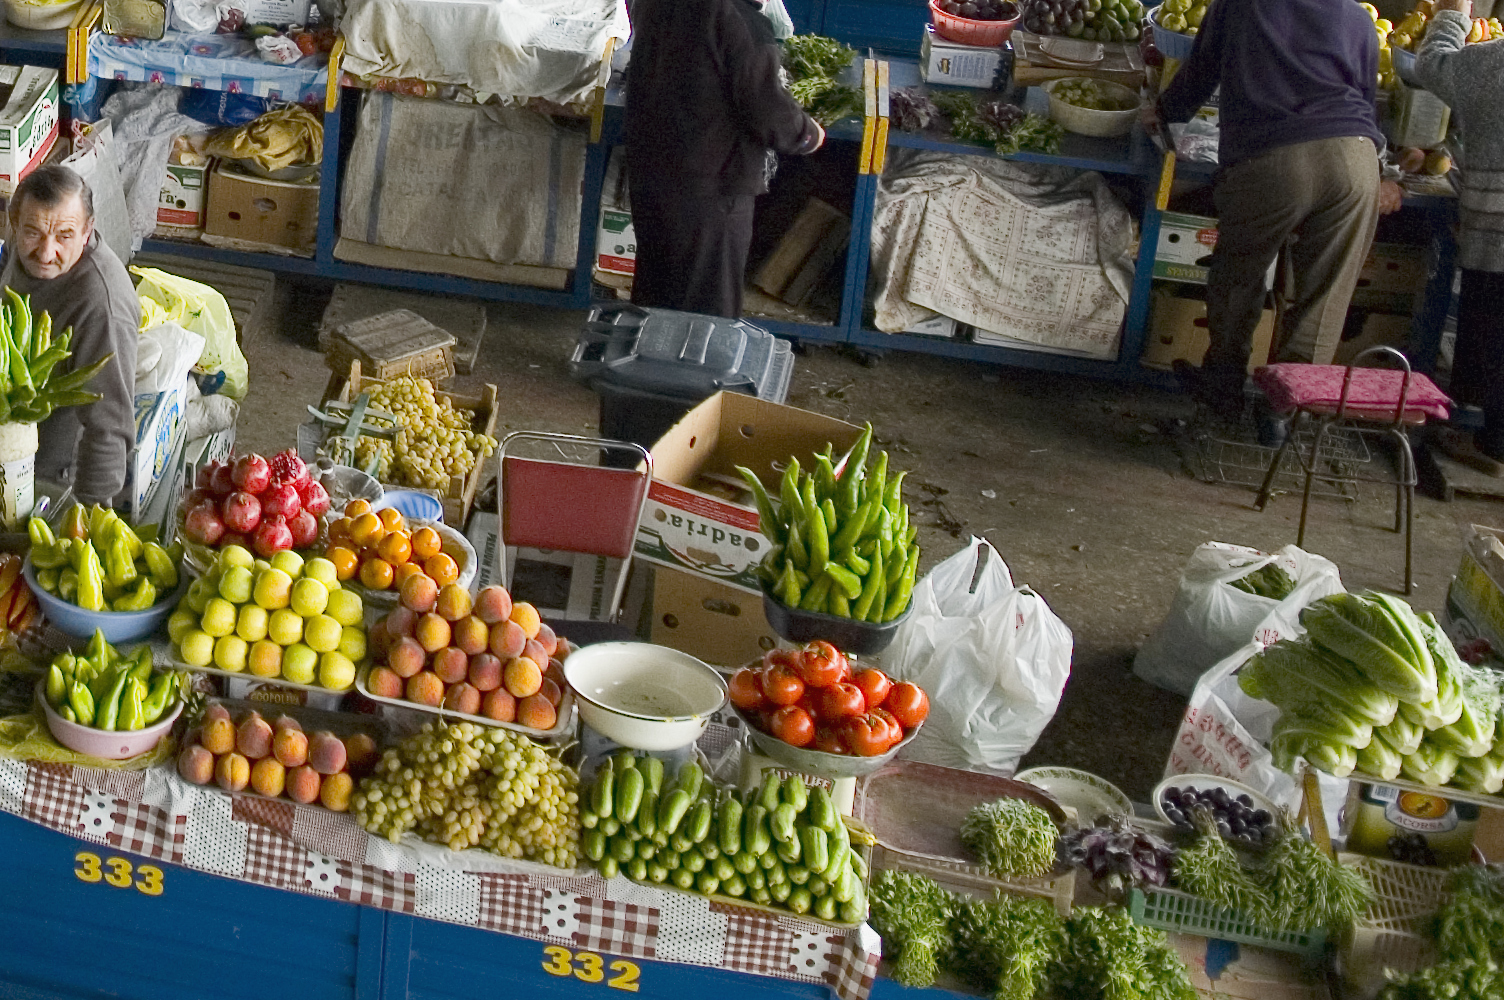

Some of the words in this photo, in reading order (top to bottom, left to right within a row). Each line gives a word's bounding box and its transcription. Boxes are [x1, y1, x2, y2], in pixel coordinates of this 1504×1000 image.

[670, 513, 743, 546] adria
[482, 532, 498, 567] PREMIUM
[1396, 814, 1445, 830] ACORSA
[74, 851, 165, 896] 333
[541, 944, 641, 992] 332
